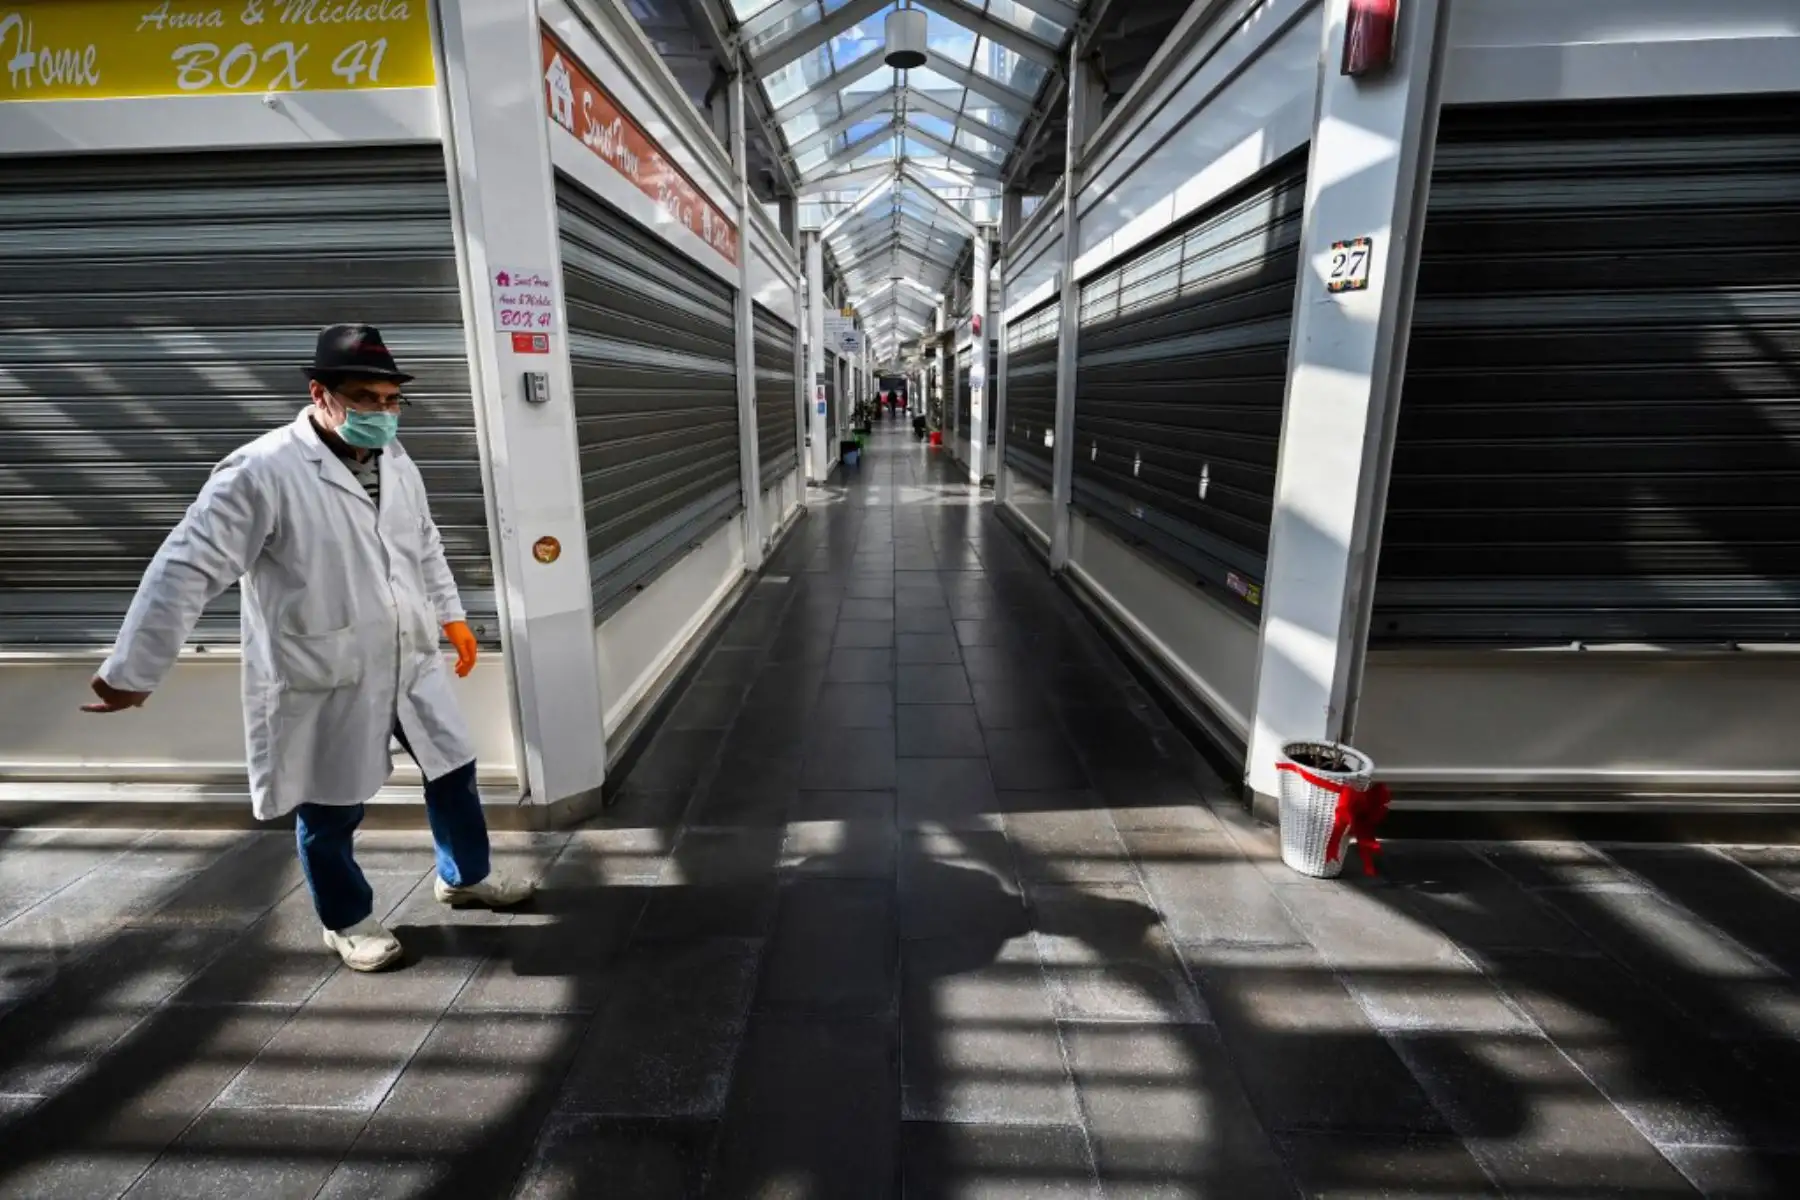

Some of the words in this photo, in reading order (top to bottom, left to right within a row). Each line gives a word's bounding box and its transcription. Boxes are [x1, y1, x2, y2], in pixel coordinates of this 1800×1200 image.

[136, 2, 225, 32] Anna
[241, 0, 265, 26] &
[271, 0, 412, 26] Michela
[0, 12, 101, 89] Home
[171, 41, 310, 91] BOX
[331, 37, 388, 84] 41
[1331, 250, 1366, 278] 27
[500, 309, 533, 328] BOX
[538, 312, 552, 328] 41
